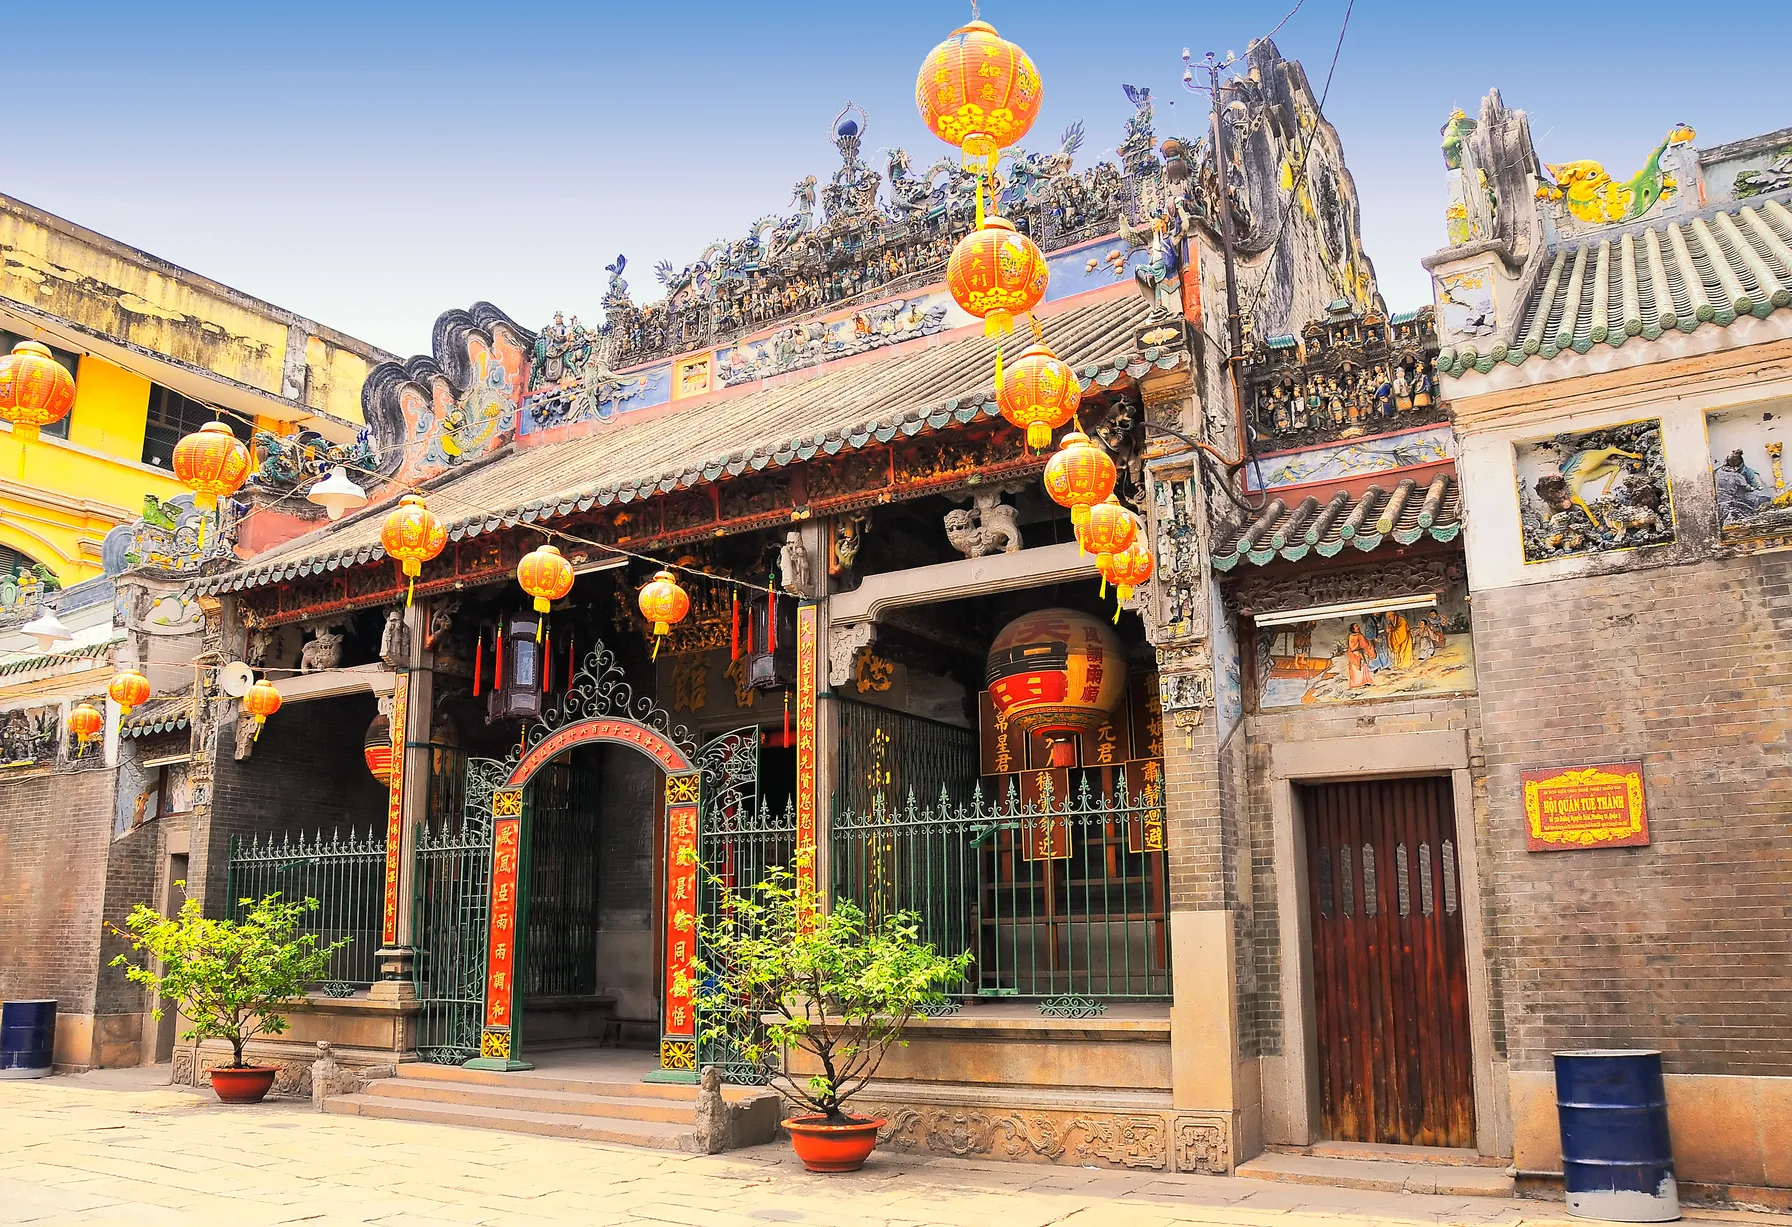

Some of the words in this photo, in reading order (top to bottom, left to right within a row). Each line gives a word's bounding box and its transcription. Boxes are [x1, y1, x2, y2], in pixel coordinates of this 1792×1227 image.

[1543, 796, 1558, 817] HỘI
[1558, 795, 1580, 815] QUÁN
[1581, 793, 1597, 813] TUỆ
[1597, 792, 1625, 810] THÀNH
